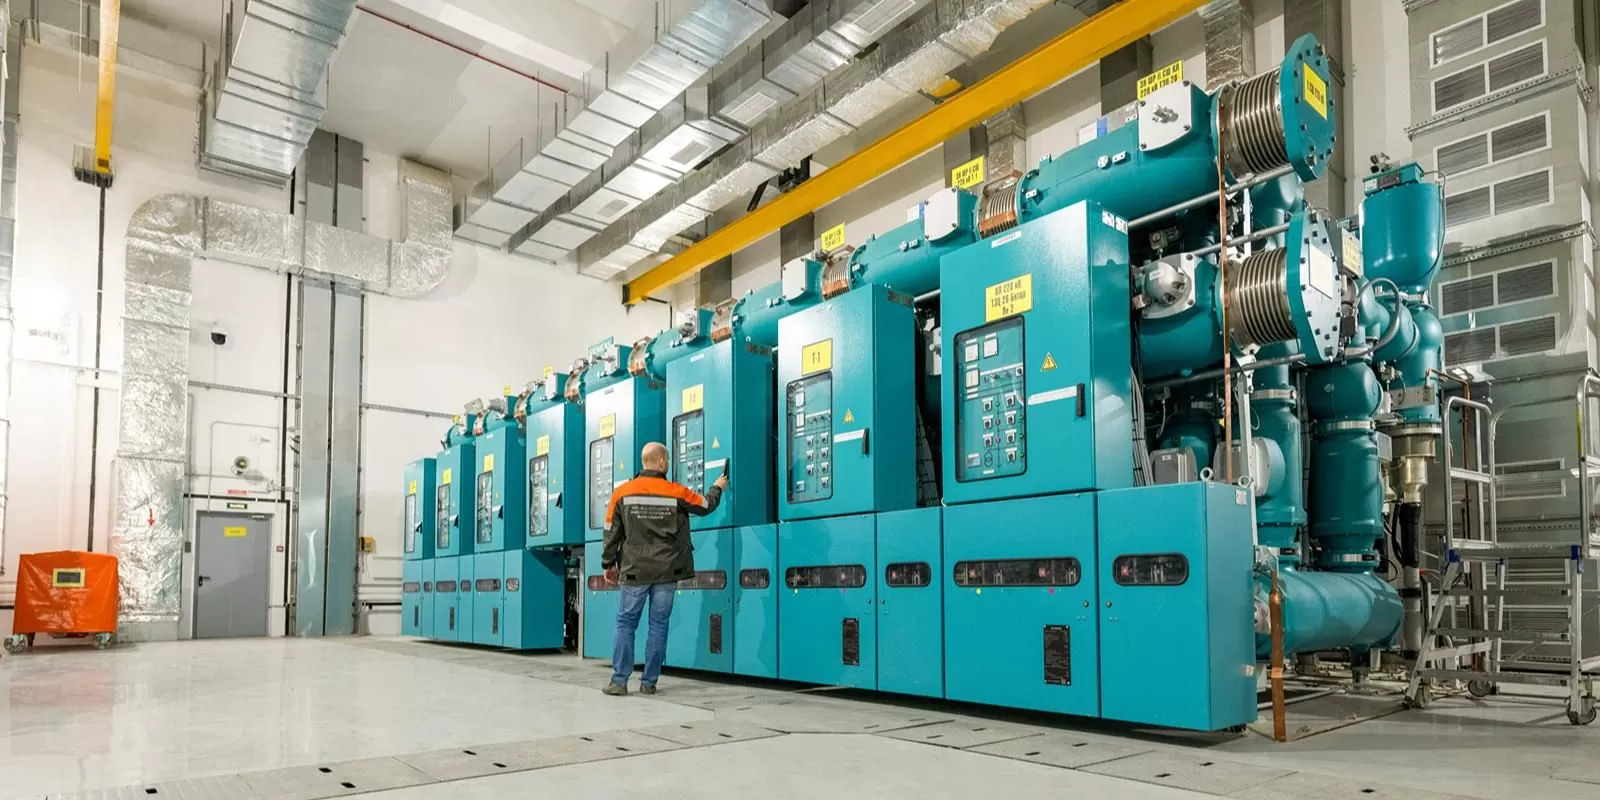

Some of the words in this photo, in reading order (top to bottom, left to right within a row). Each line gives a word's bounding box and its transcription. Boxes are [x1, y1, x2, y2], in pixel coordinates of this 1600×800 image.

[1140, 86, 1150, 98] 220
[1003, 281, 1014, 293] 220
[1002, 294, 1009, 305] 26
